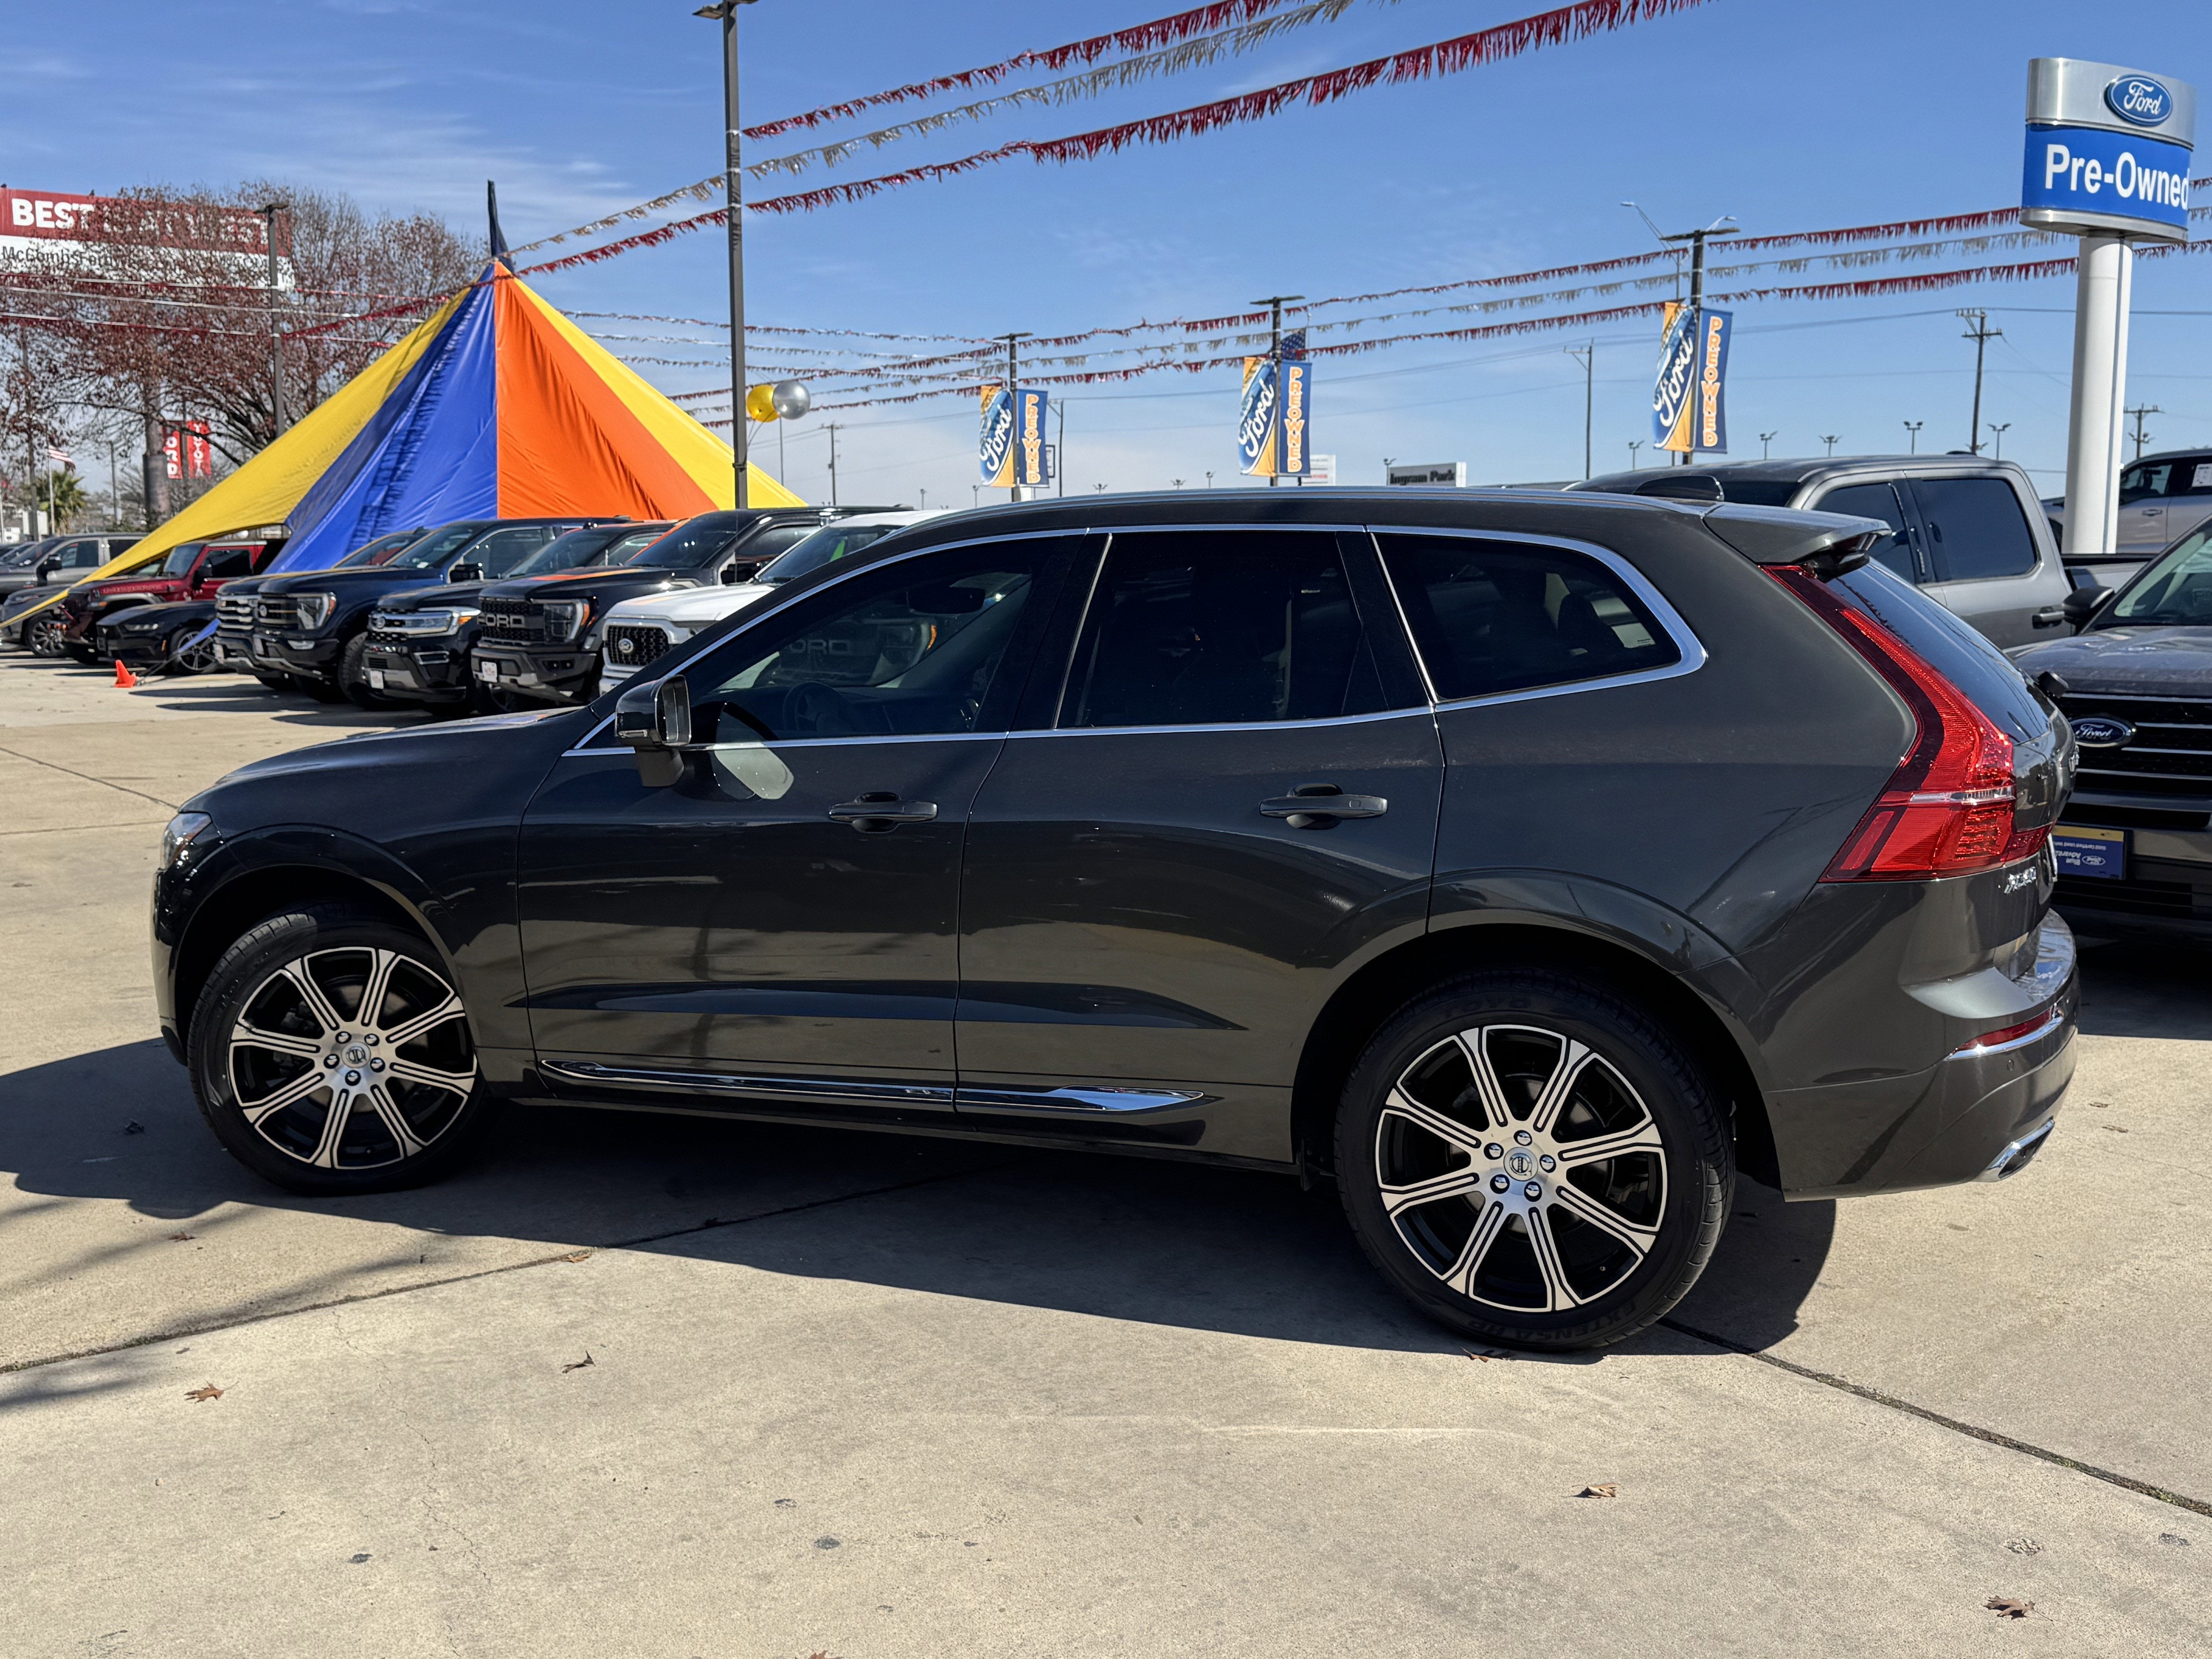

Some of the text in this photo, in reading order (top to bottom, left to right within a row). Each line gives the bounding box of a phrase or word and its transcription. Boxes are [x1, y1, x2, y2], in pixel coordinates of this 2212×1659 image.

[2123, 81, 2162, 115] Ford
[2045, 144, 2190, 211] Pre-Owned
[12, 198, 95, 230] BEST
[1653, 328, 1693, 426] Ford
[1701, 316, 1723, 447] PREOWNED
[166, 427, 179, 476] ORD
[979, 404, 1012, 471] Ford
[1022, 393, 1042, 484] PREOWNED
[1238, 379, 1274, 457] Ford
[1284, 366, 1305, 473] PREOWNED
[477, 612, 525, 628] FORD
[785, 639, 853, 656] ORD
[2075, 723, 2113, 736] Ford
